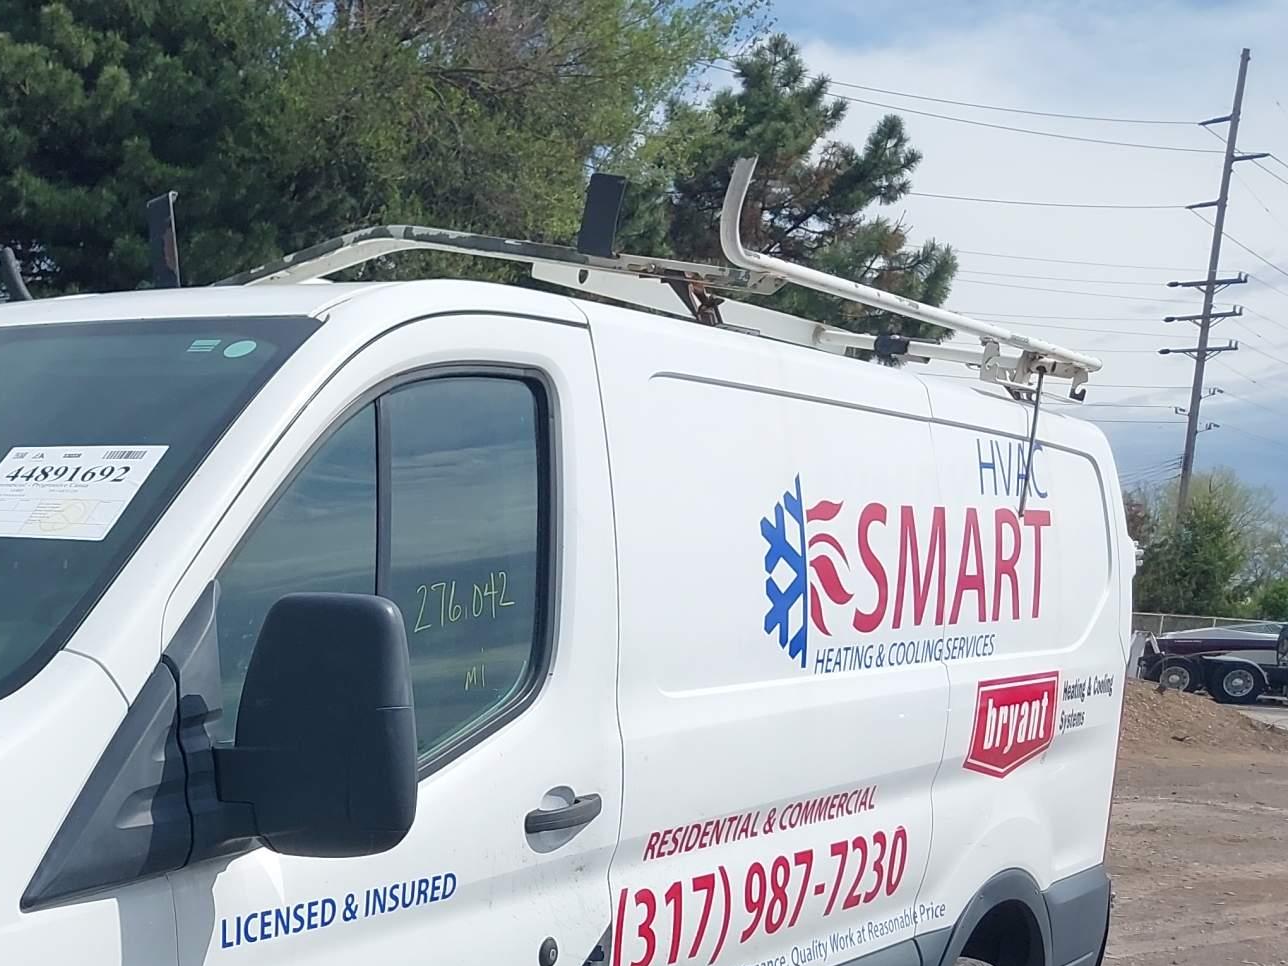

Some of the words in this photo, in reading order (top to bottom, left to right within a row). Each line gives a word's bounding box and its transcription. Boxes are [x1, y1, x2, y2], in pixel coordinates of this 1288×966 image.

[5, 465, 131, 483] 44891692
[976, 438, 1048, 498] HVAC
[852, 502, 1051, 633] SMART
[814, 645, 874, 675] HEATING
[875, 644, 887, 667] &
[887, 638, 944, 666] COOLING
[944, 634, 996, 660] SERVICES
[1062, 680, 1086, 702] Heating
[1086, 676, 1092, 696] &
[1093, 674, 1114, 697] Cooling
[983, 691, 1049, 754] bryant
[1059, 709, 1086, 734] Systems
[643, 811, 761, 861] RESIDENTIAL
[763, 807, 777, 835] &
[779, 785, 877, 831] COMMERCIAL
[221, 898, 336, 949] LICENSED
[342, 893, 358, 922] &
[364, 872, 457, 917] INSURED
[740, 826, 907, 945] 987-7230
[829, 927, 856, 953] Work
[856, 929, 866, 944] at
[867, 907, 918, 941] Reasonable
[919, 902, 946, 924] Price
